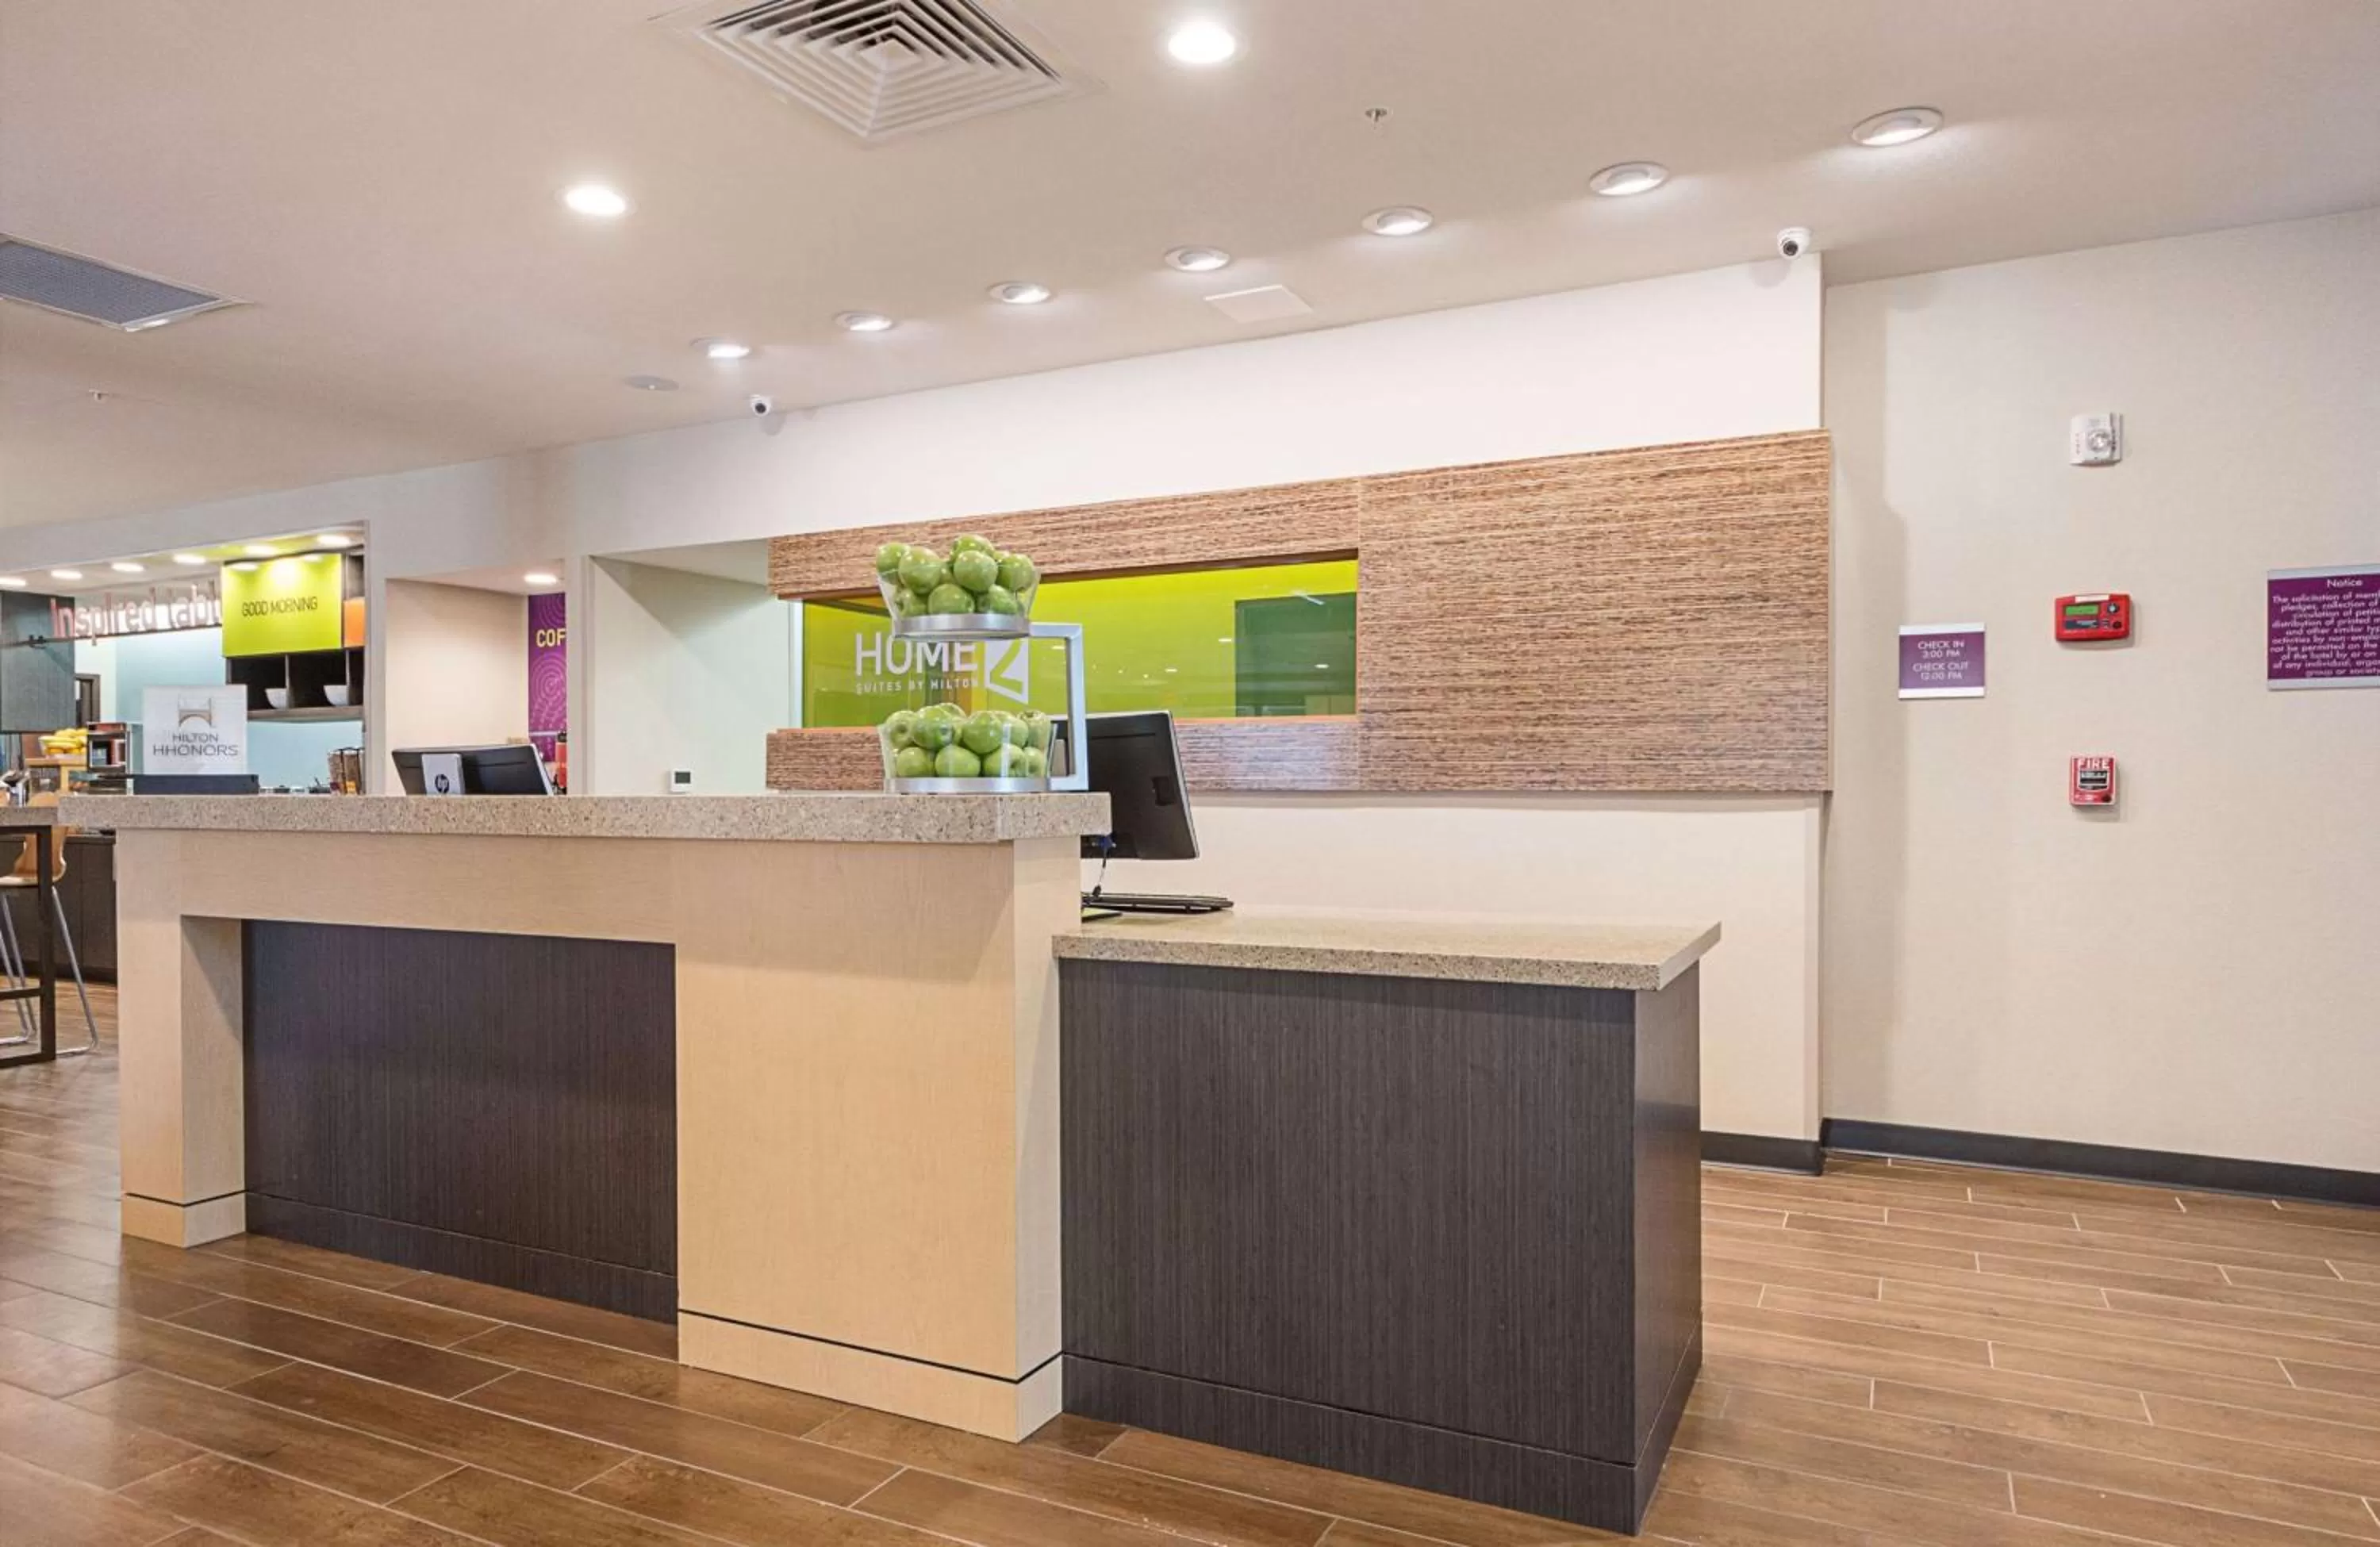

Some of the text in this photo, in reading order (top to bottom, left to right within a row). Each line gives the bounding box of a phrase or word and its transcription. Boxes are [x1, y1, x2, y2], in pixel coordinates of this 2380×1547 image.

[2327, 579, 2363, 588] Notice
[2272, 595, 2289, 604] The
[2369, 598, 2378, 607] of
[242, 596, 317, 616] GOOD MORNING
[2343, 608, 2352, 617] of
[2306, 626, 2330, 635] other
[536, 628, 566, 647] COF
[2313, 635, 2325, 644] by
[2302, 643, 2345, 653] permitted
[855, 631, 978, 676] HOME
[2281, 651, 2290, 660] of
[2310, 650, 2333, 658] hotel
[2336, 650, 2347, 659] by
[1913, 661, 1967, 672] CHECK OUT
[2273, 660, 2282, 669] of
[856, 678, 978, 696] SUITES BY HILTON
[152, 732, 239, 756] HILTON HHONORS
[2078, 758, 2110, 769] FIRE
